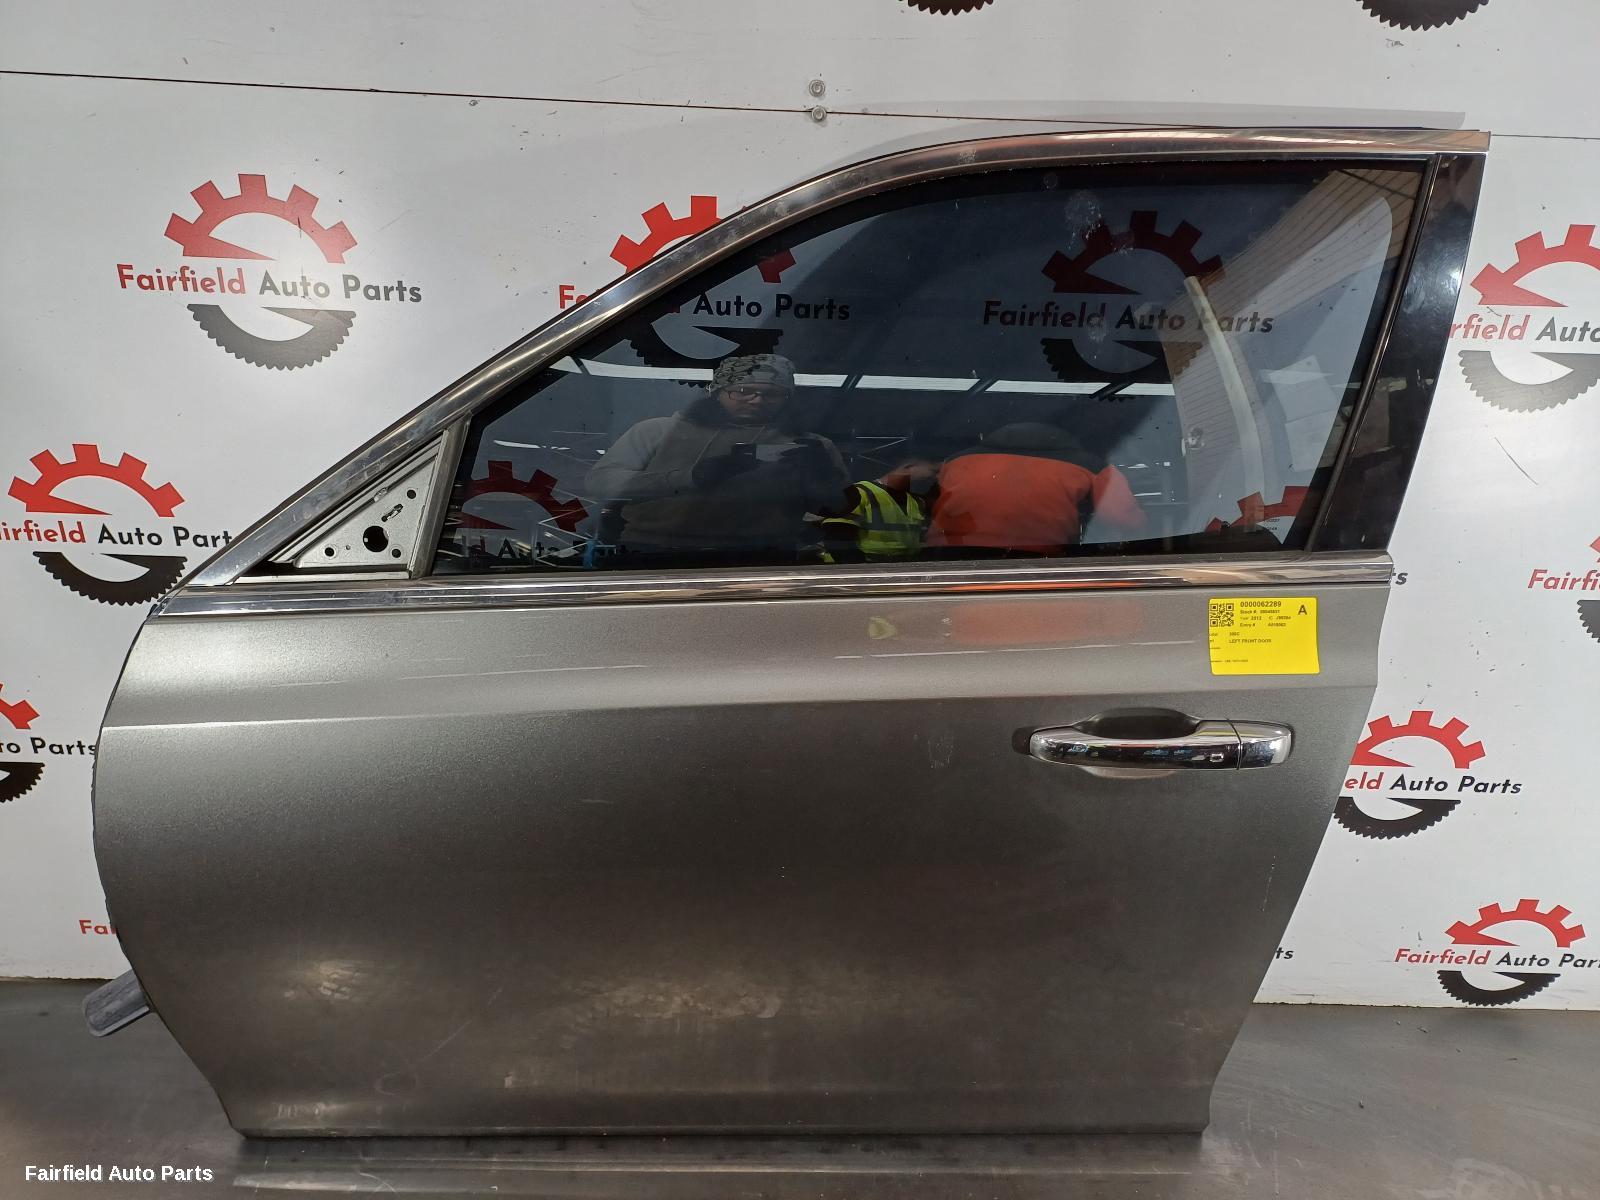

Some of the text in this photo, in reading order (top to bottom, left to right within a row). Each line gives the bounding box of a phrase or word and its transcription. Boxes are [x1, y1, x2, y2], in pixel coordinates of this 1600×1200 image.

[117, 264, 422, 303] Fairfield Auto Parts
[692, 291, 851, 321] Auto Parts
[983, 300, 1106, 328] Fairfield
[1115, 304, 1186, 331] Auto
[0, 519, 86, 544] irfield
[98, 523, 163, 546] Auto
[1527, 568, 1600, 591] Fairfi
[1297, 604, 1308, 616] A
[1389, 773, 1449, 792] Auto
[1457, 775, 1523, 794] Parts
[1394, 948, 1600, 969] Fairfield Auto Par
